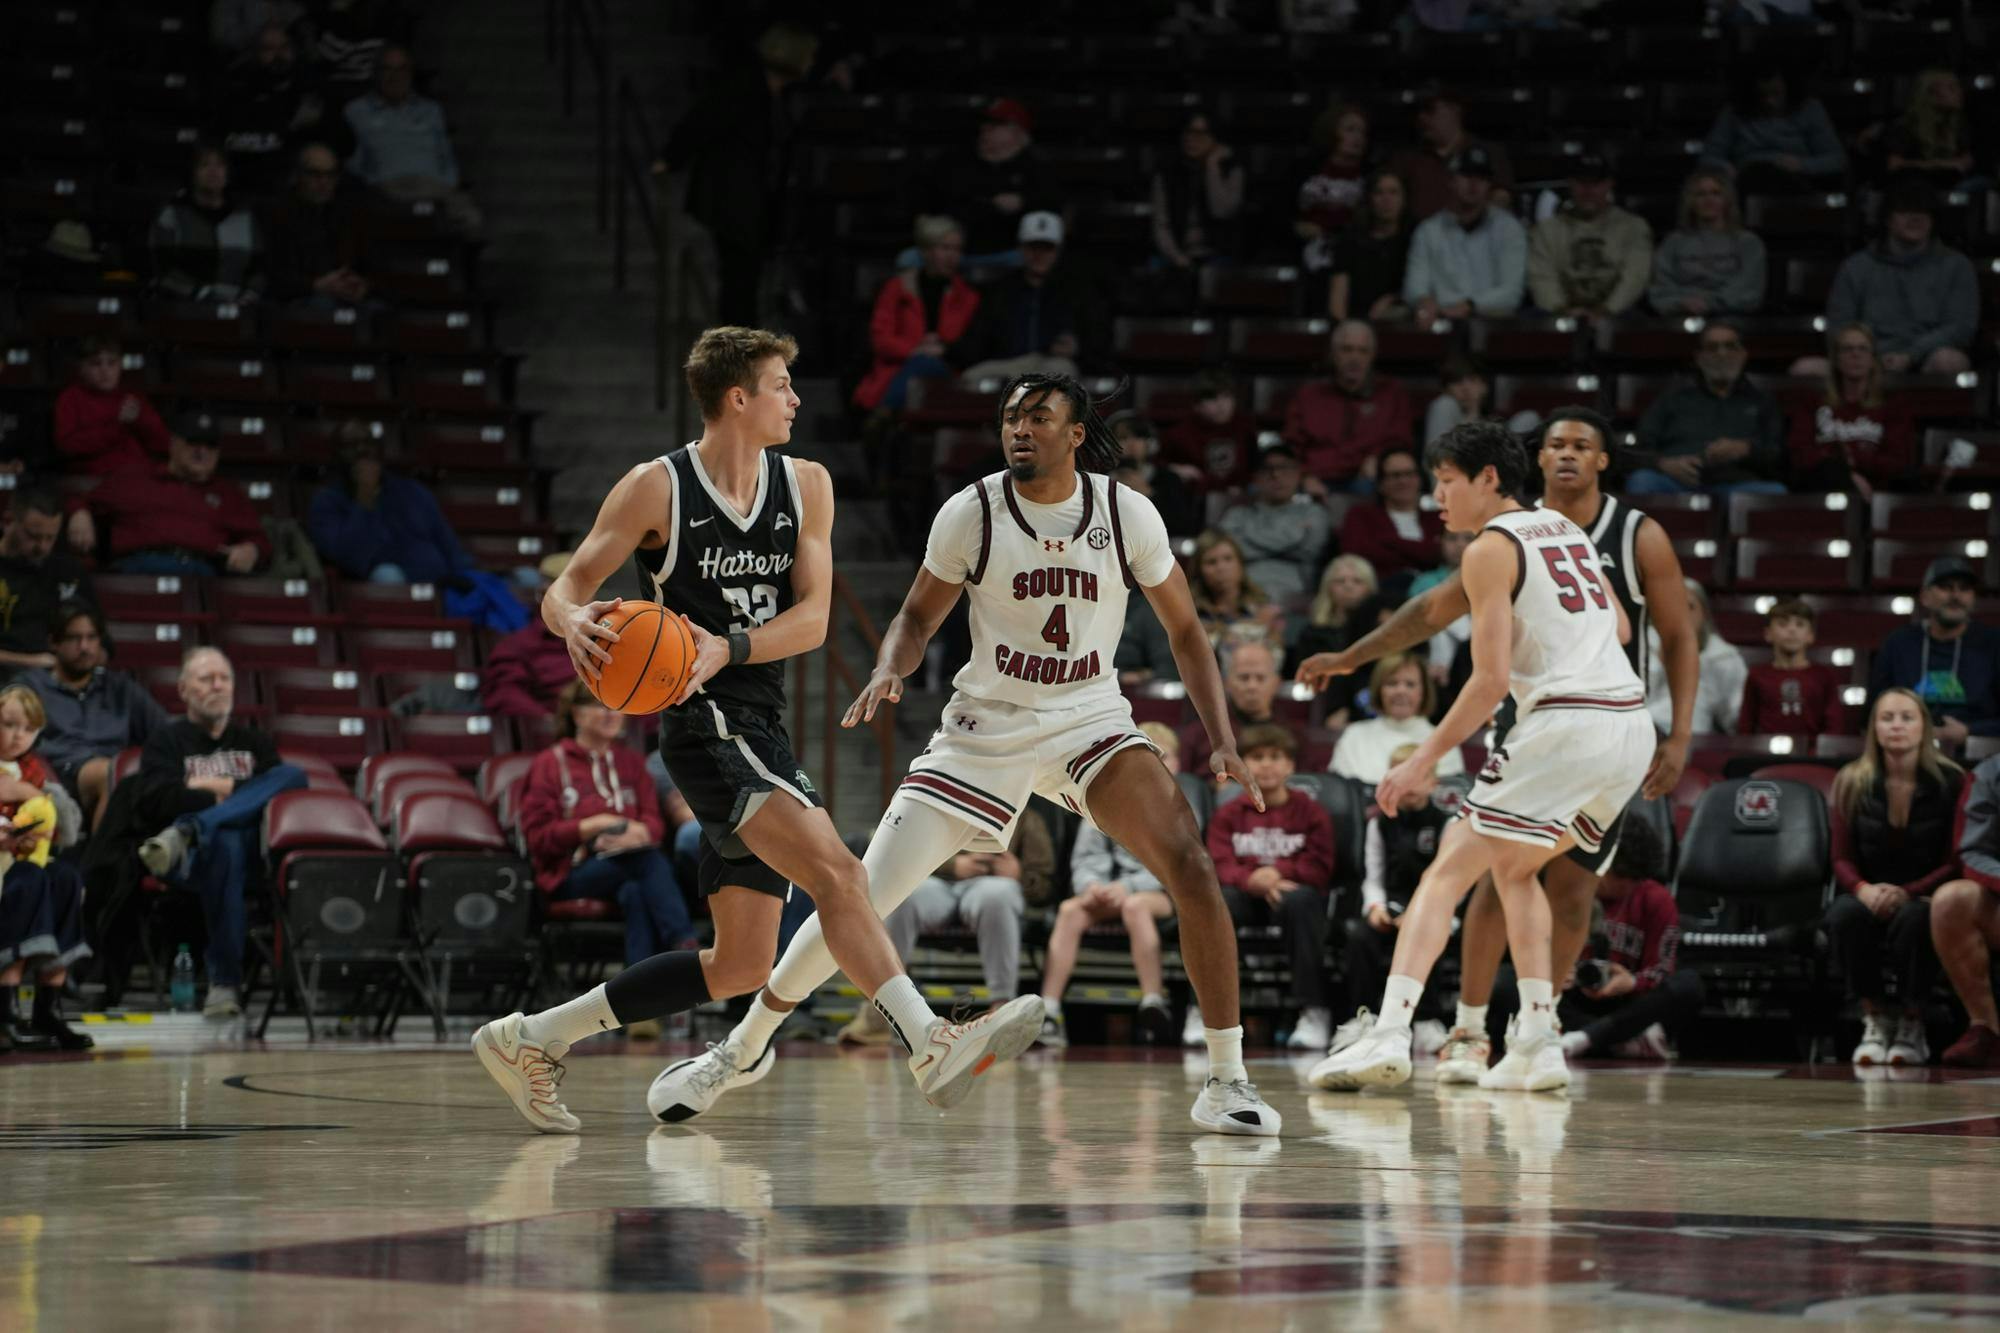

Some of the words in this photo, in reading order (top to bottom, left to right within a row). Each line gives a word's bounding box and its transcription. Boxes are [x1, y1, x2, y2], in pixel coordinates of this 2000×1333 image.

[1088, 528, 1110, 549] SEC
[698, 547, 794, 579] Hatters
[1538, 544, 1609, 614] 55
[1013, 567, 1098, 602] SOUTH
[721, 583, 779, 634] 32
[1041, 604, 1070, 652] 4
[995, 643, 1101, 685] CAROLINA
[494, 866, 519, 903] 2
